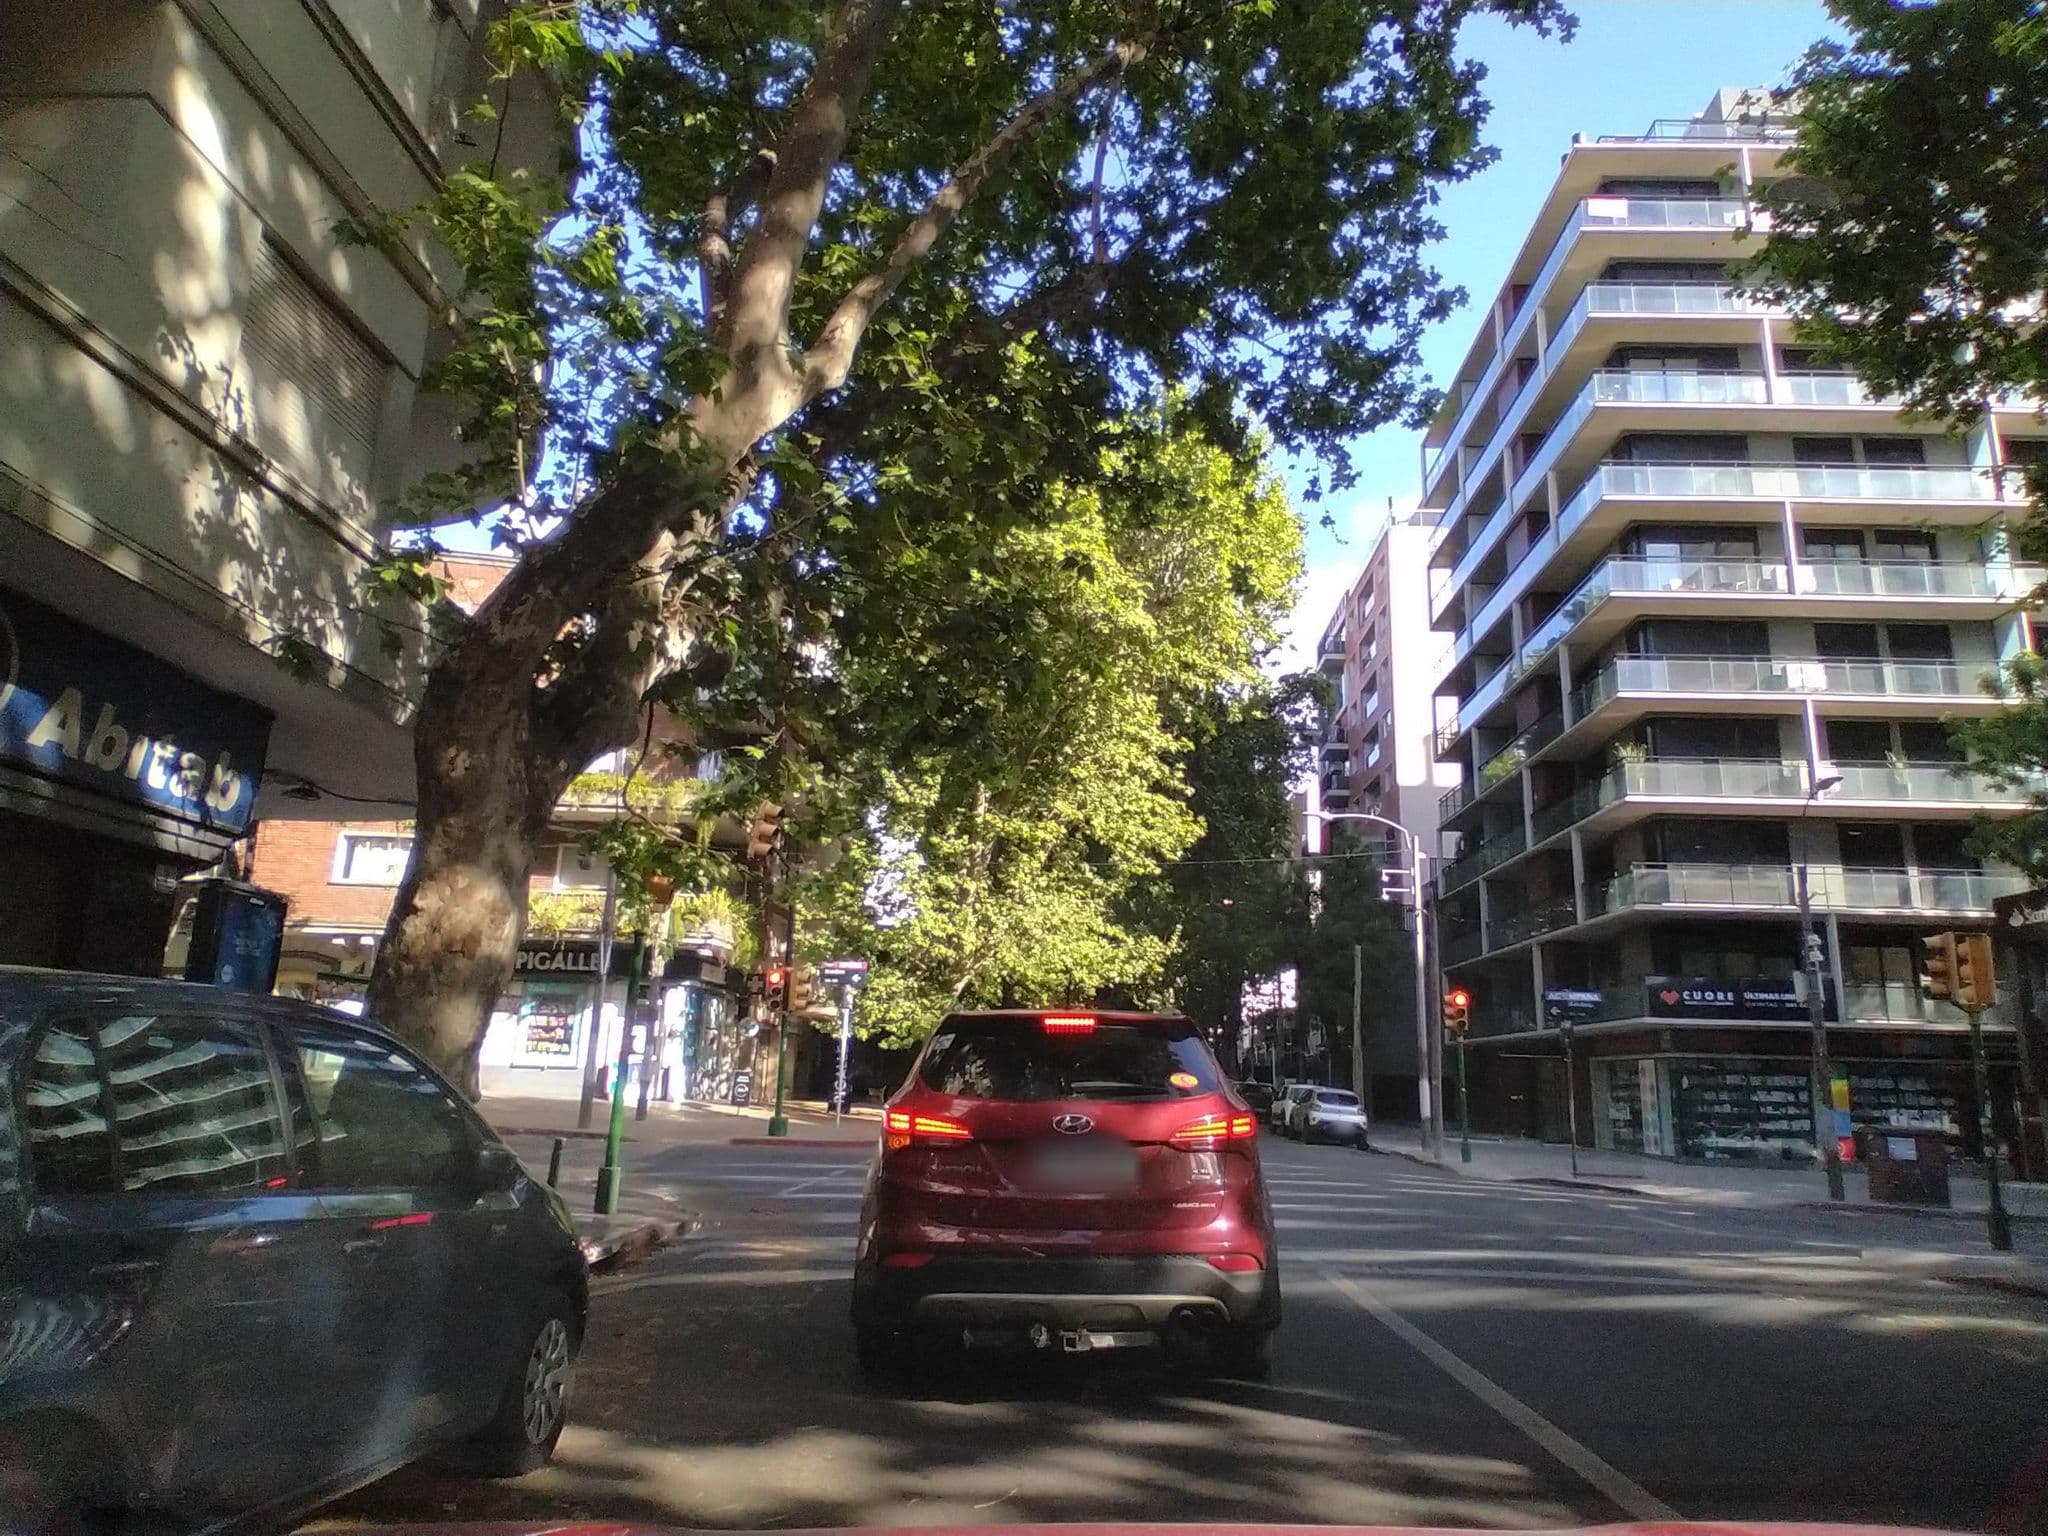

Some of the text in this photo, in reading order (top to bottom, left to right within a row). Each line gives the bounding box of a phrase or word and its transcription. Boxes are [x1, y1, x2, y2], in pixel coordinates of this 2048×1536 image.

[27, 687, 241, 812] Abitab
[515, 950, 601, 971] PIGALLE
[1682, 990, 1735, 1001] CUORE
